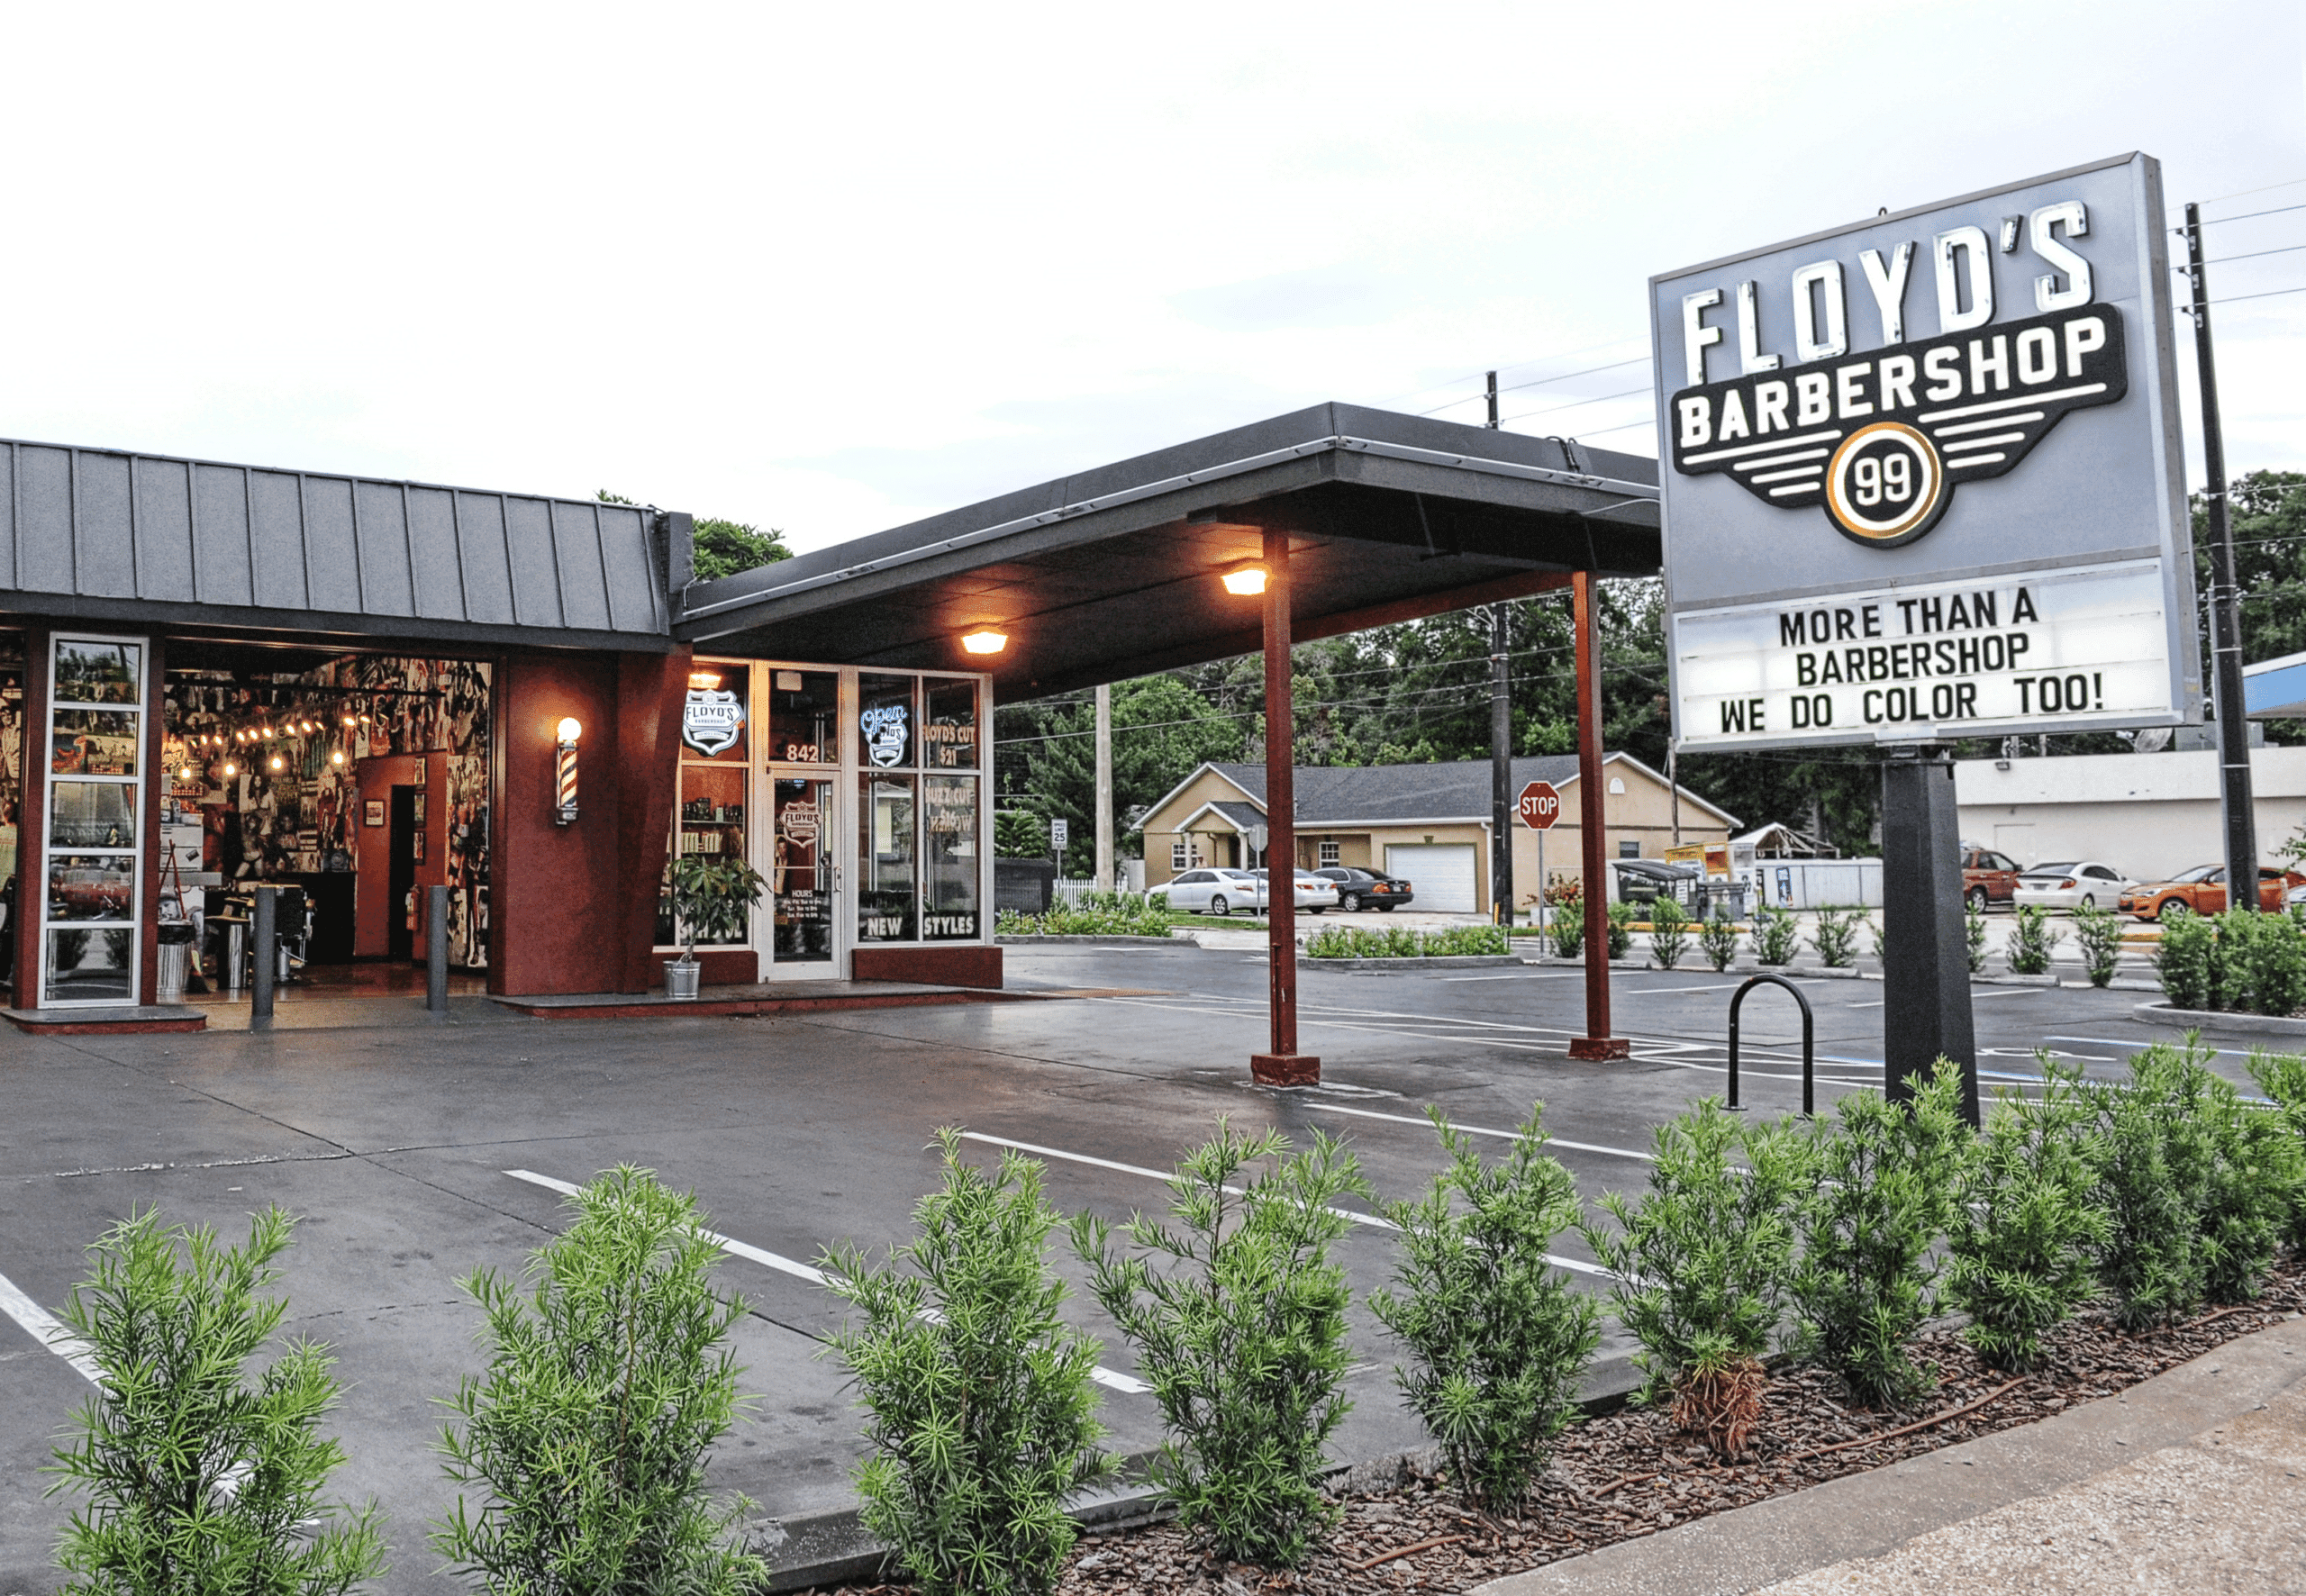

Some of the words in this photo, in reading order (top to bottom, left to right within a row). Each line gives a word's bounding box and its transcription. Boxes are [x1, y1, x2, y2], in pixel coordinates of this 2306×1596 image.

[1682, 199, 2095, 387] FLOYD'S
[1678, 316, 2107, 449] BARBERSHOP
[1854, 451, 1912, 507] 99
[1780, 604, 1882, 647] MORE
[1897, 591, 1997, 635] THAN
[2011, 586, 2038, 624] A
[1797, 632, 2030, 686] BARBERSHOP
[1720, 697, 1766, 733] WE
[1791, 694, 1833, 730] DO
[1862, 682, 1978, 724] COLOR
[2013, 672, 2104, 713] TOO!
[685, 706, 734, 721] FLOYD'S
[957, 725, 976, 743] CUT
[786, 744, 819, 762] 842
[940, 744, 957, 766] $21
[1521, 796, 1557, 815] STOP
[1054, 832, 1066, 842] 25
[792, 889, 813, 898] HOURS
[867, 916, 903, 937] NEW
[923, 916, 974, 936] STYLES
